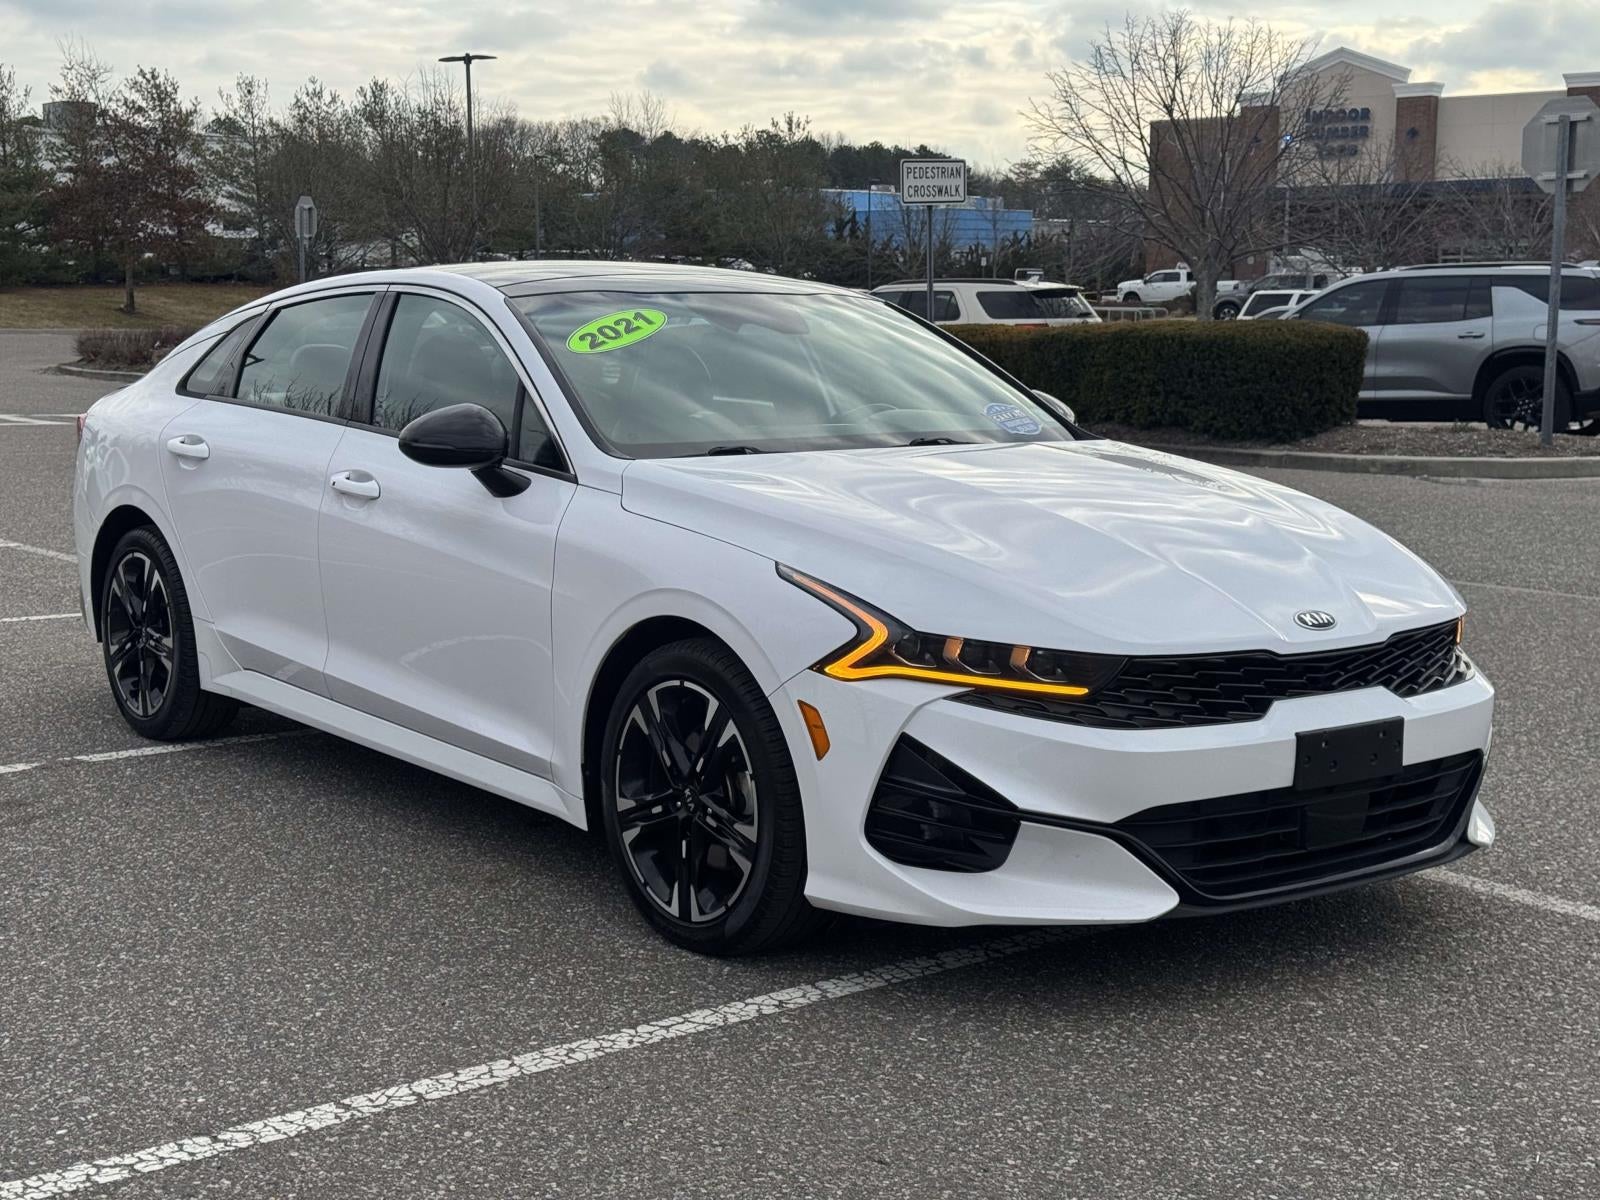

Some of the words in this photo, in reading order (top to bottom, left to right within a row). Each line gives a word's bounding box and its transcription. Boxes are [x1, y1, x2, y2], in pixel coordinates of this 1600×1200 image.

[905, 166, 962, 180] PEDESTRIAN
[907, 184, 961, 198] CROSSWALK
[578, 311, 656, 350] 2021
[1299, 611, 1335, 626] KIA
